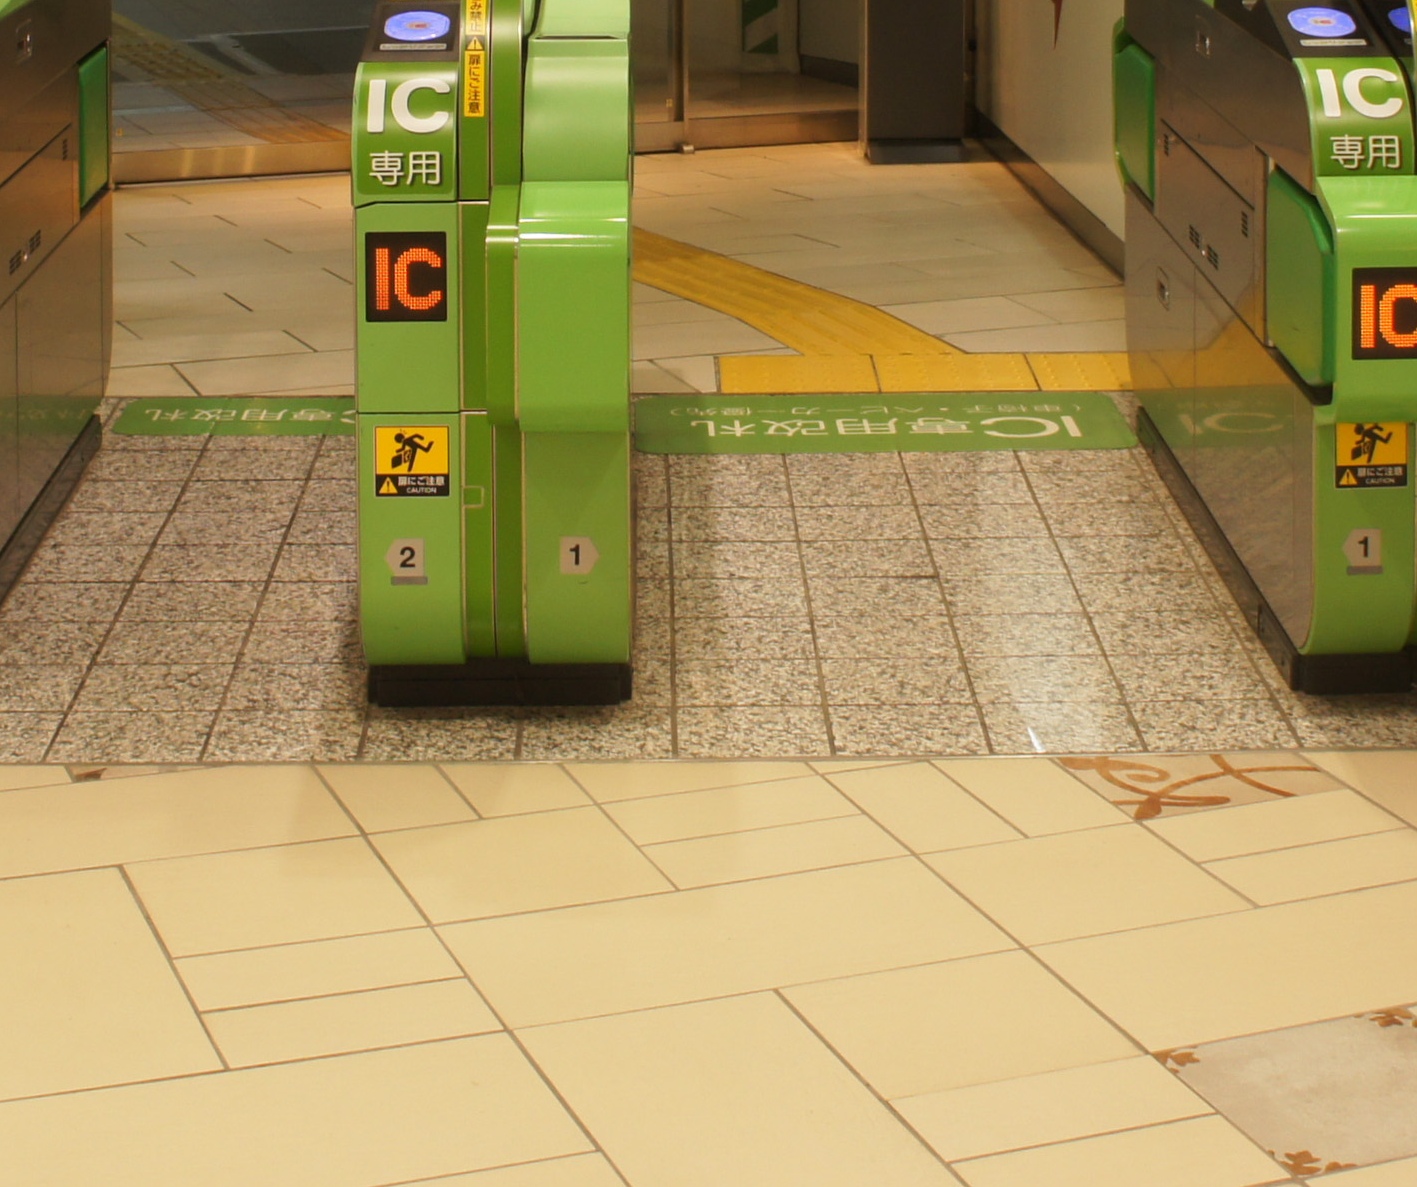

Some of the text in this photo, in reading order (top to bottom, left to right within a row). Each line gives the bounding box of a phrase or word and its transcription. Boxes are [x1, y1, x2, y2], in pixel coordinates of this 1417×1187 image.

[467, 54, 482, 114] 扉にご注意
[1316, 68, 1403, 119] IC
[367, 78, 451, 133] IC
[368, 150, 441, 187] 専用
[1330, 135, 1401, 170] 専用
[376, 247, 442, 310] IC
[690, 415, 1082, 438] IC専用改札
[399, 546, 416, 568] 2
[568, 545, 581, 567] 1
[1357, 536, 1369, 558] 1
